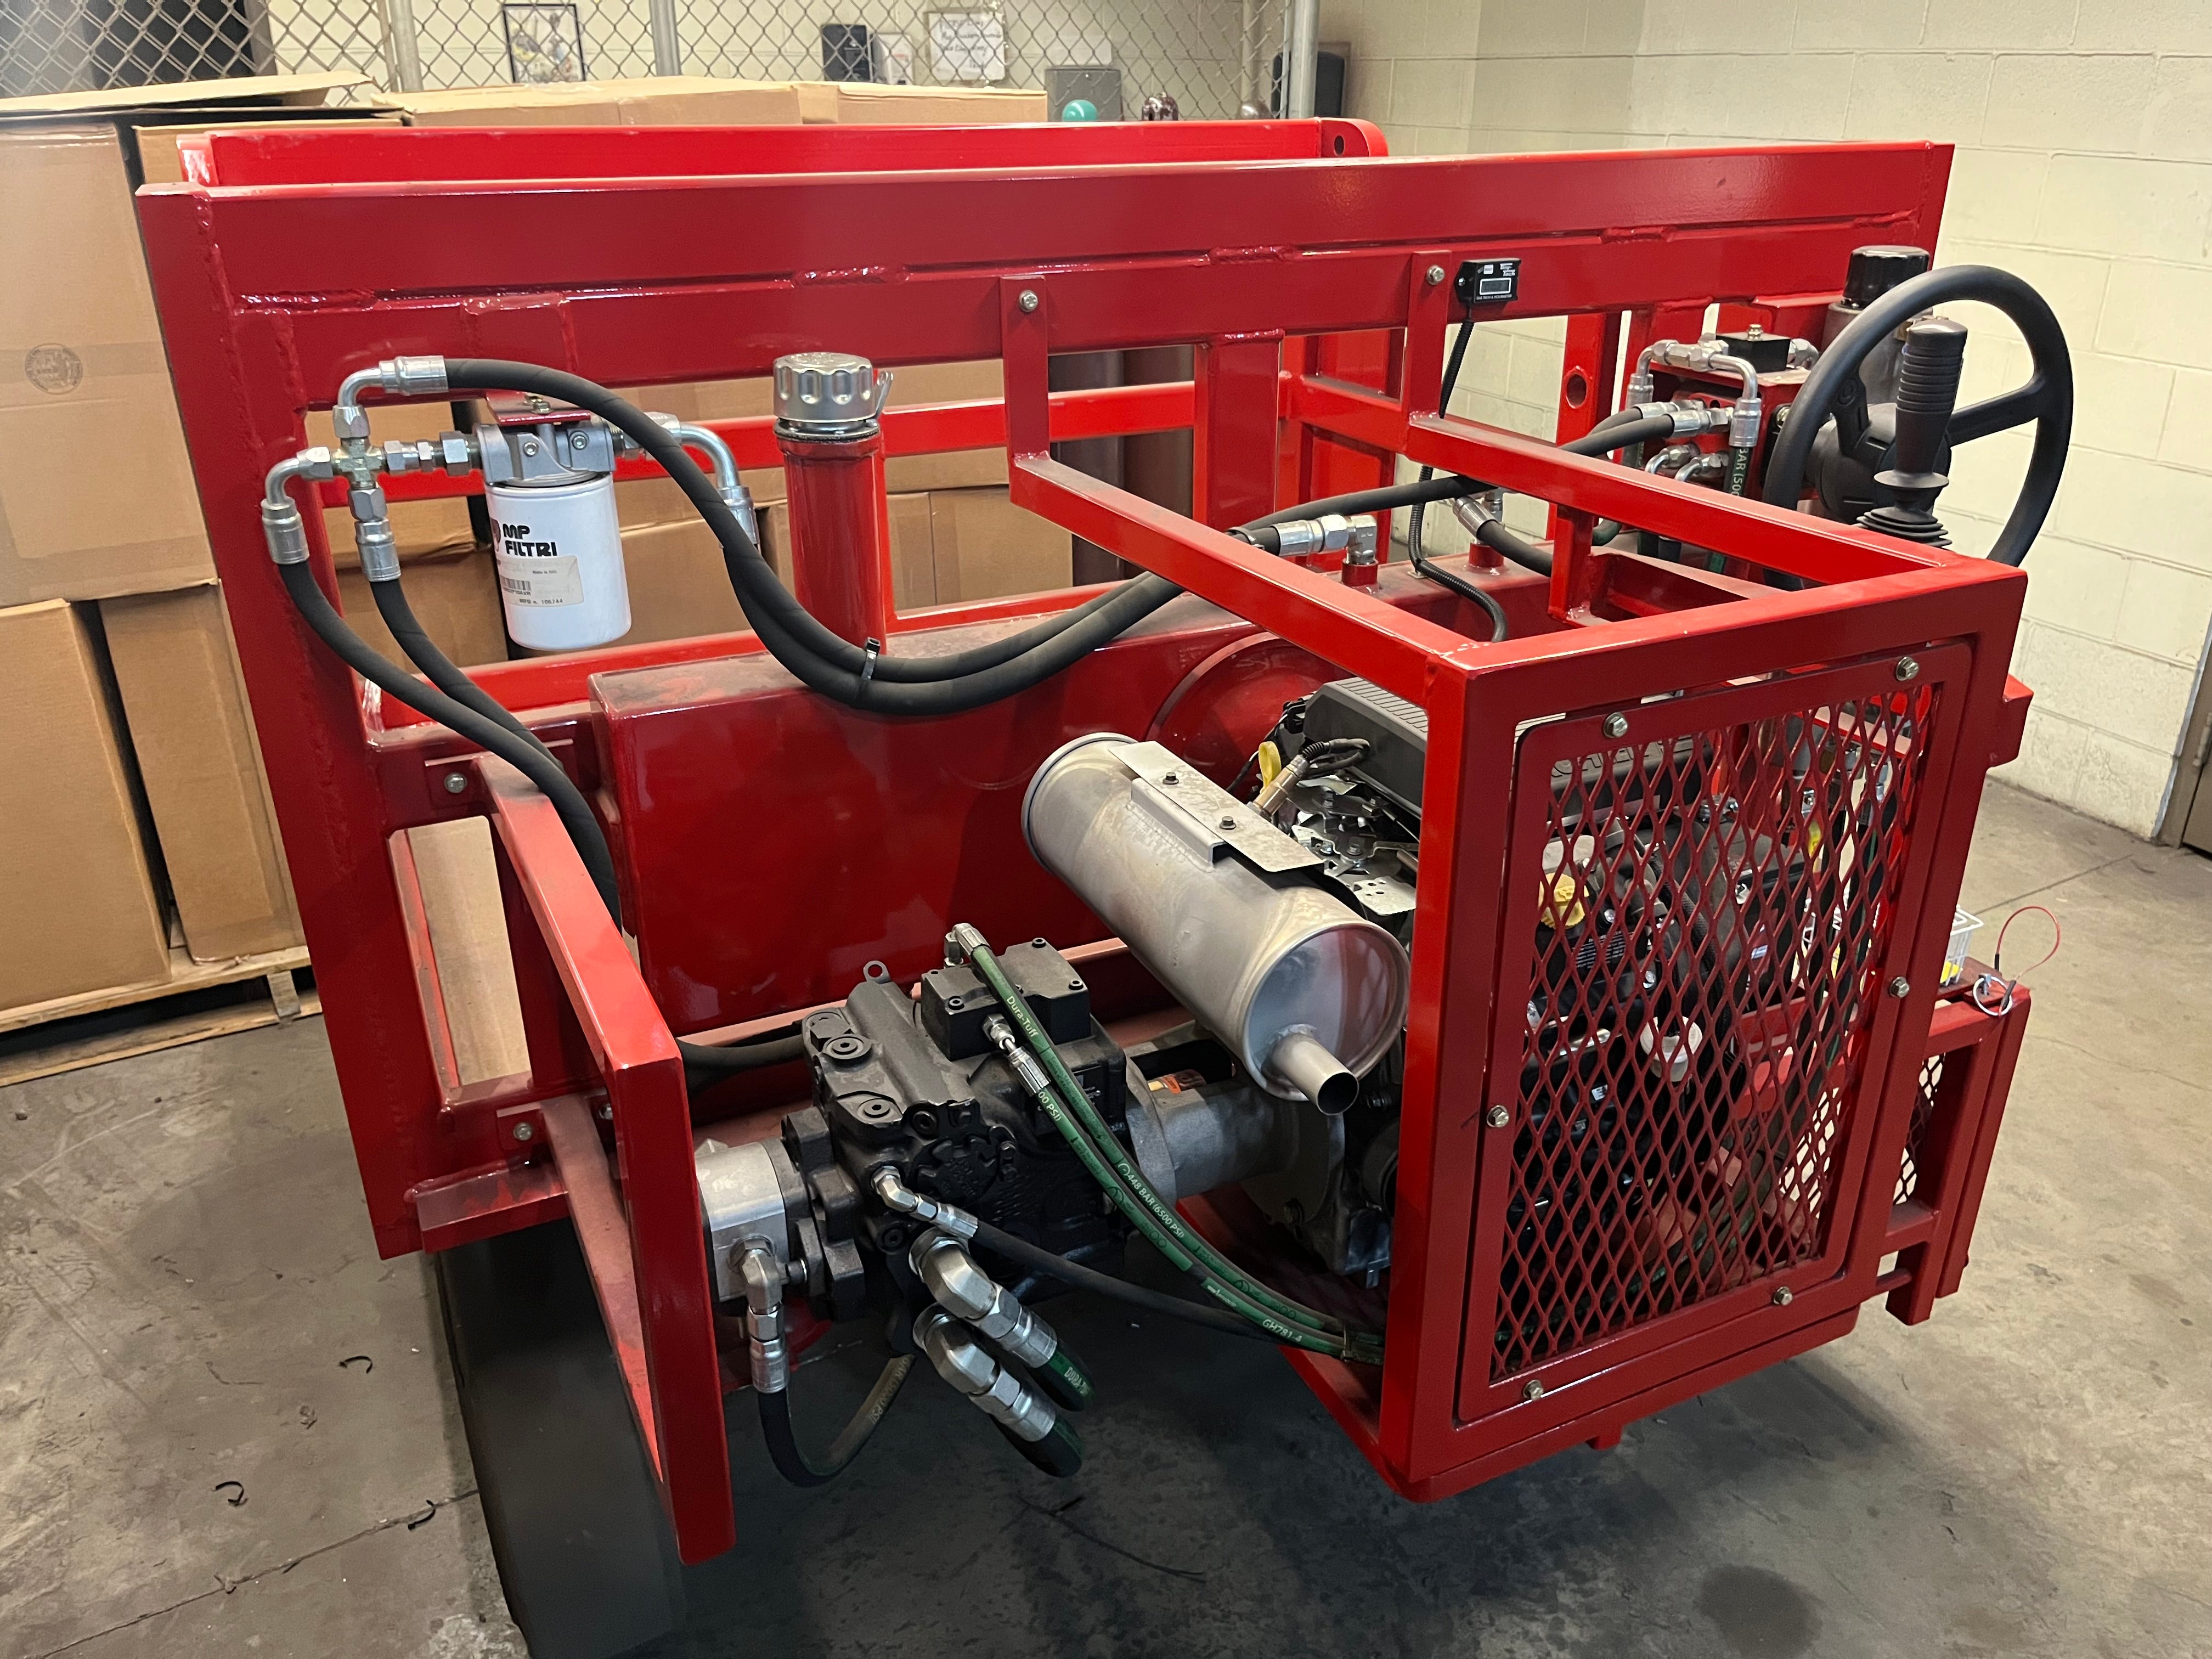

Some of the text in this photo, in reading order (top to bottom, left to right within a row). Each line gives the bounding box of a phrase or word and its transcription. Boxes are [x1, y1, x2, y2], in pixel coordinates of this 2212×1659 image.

[1735, 448, 1749, 470] BAR
[503, 523, 531, 540] MP
[505, 540, 558, 557] FILTRI
[1006, 996, 1039, 1038] Dura-Tuff
[1046, 1103, 1062, 1122] PSI)
[1128, 1175, 1142, 1189] 448
[1138, 1188, 1155, 1206] BAR
[1152, 1204, 1172, 1224] (6500
[1170, 1223, 1185, 1238] PSI)
[1262, 1319, 1303, 1342] GH781-4
